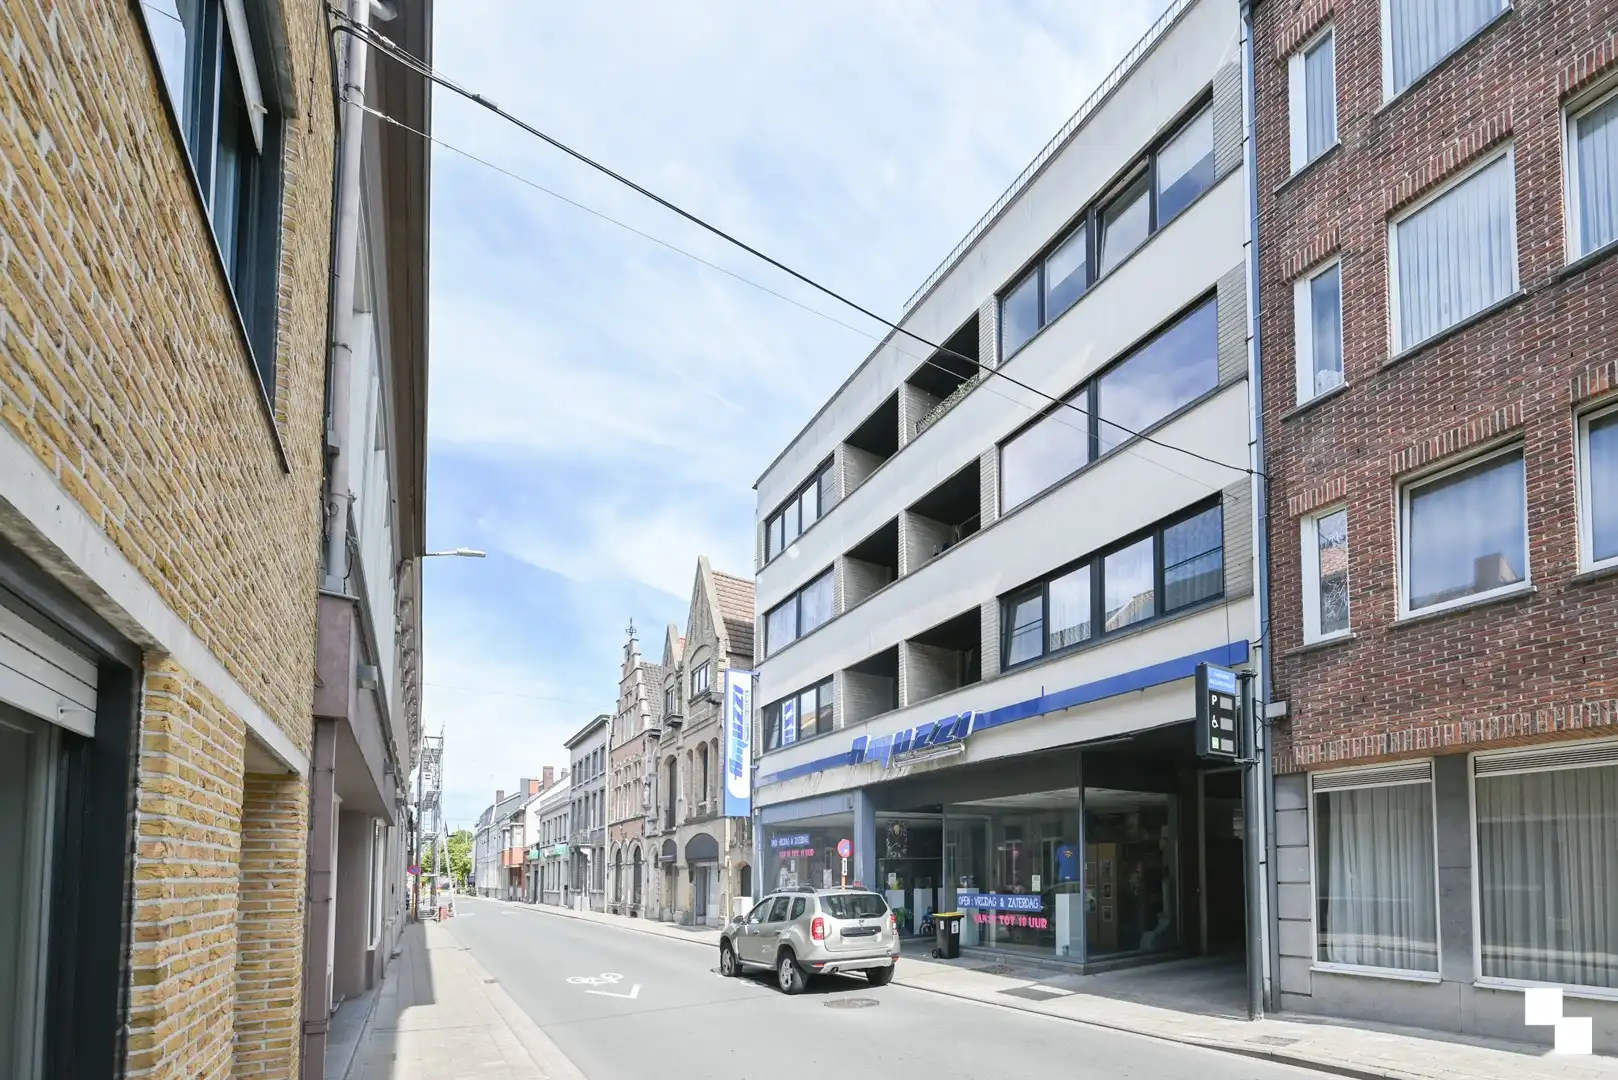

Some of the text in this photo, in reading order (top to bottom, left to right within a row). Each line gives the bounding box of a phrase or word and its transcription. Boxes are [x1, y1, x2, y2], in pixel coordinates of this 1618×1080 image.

[1212, 694, 1218, 705] P
[973, 896, 996, 907] VRIJDAG
[1007, 898, 1039, 909] ZATERDAG
[999, 914, 1016, 926] TOT
[1028, 917, 1047, 928] UUR
